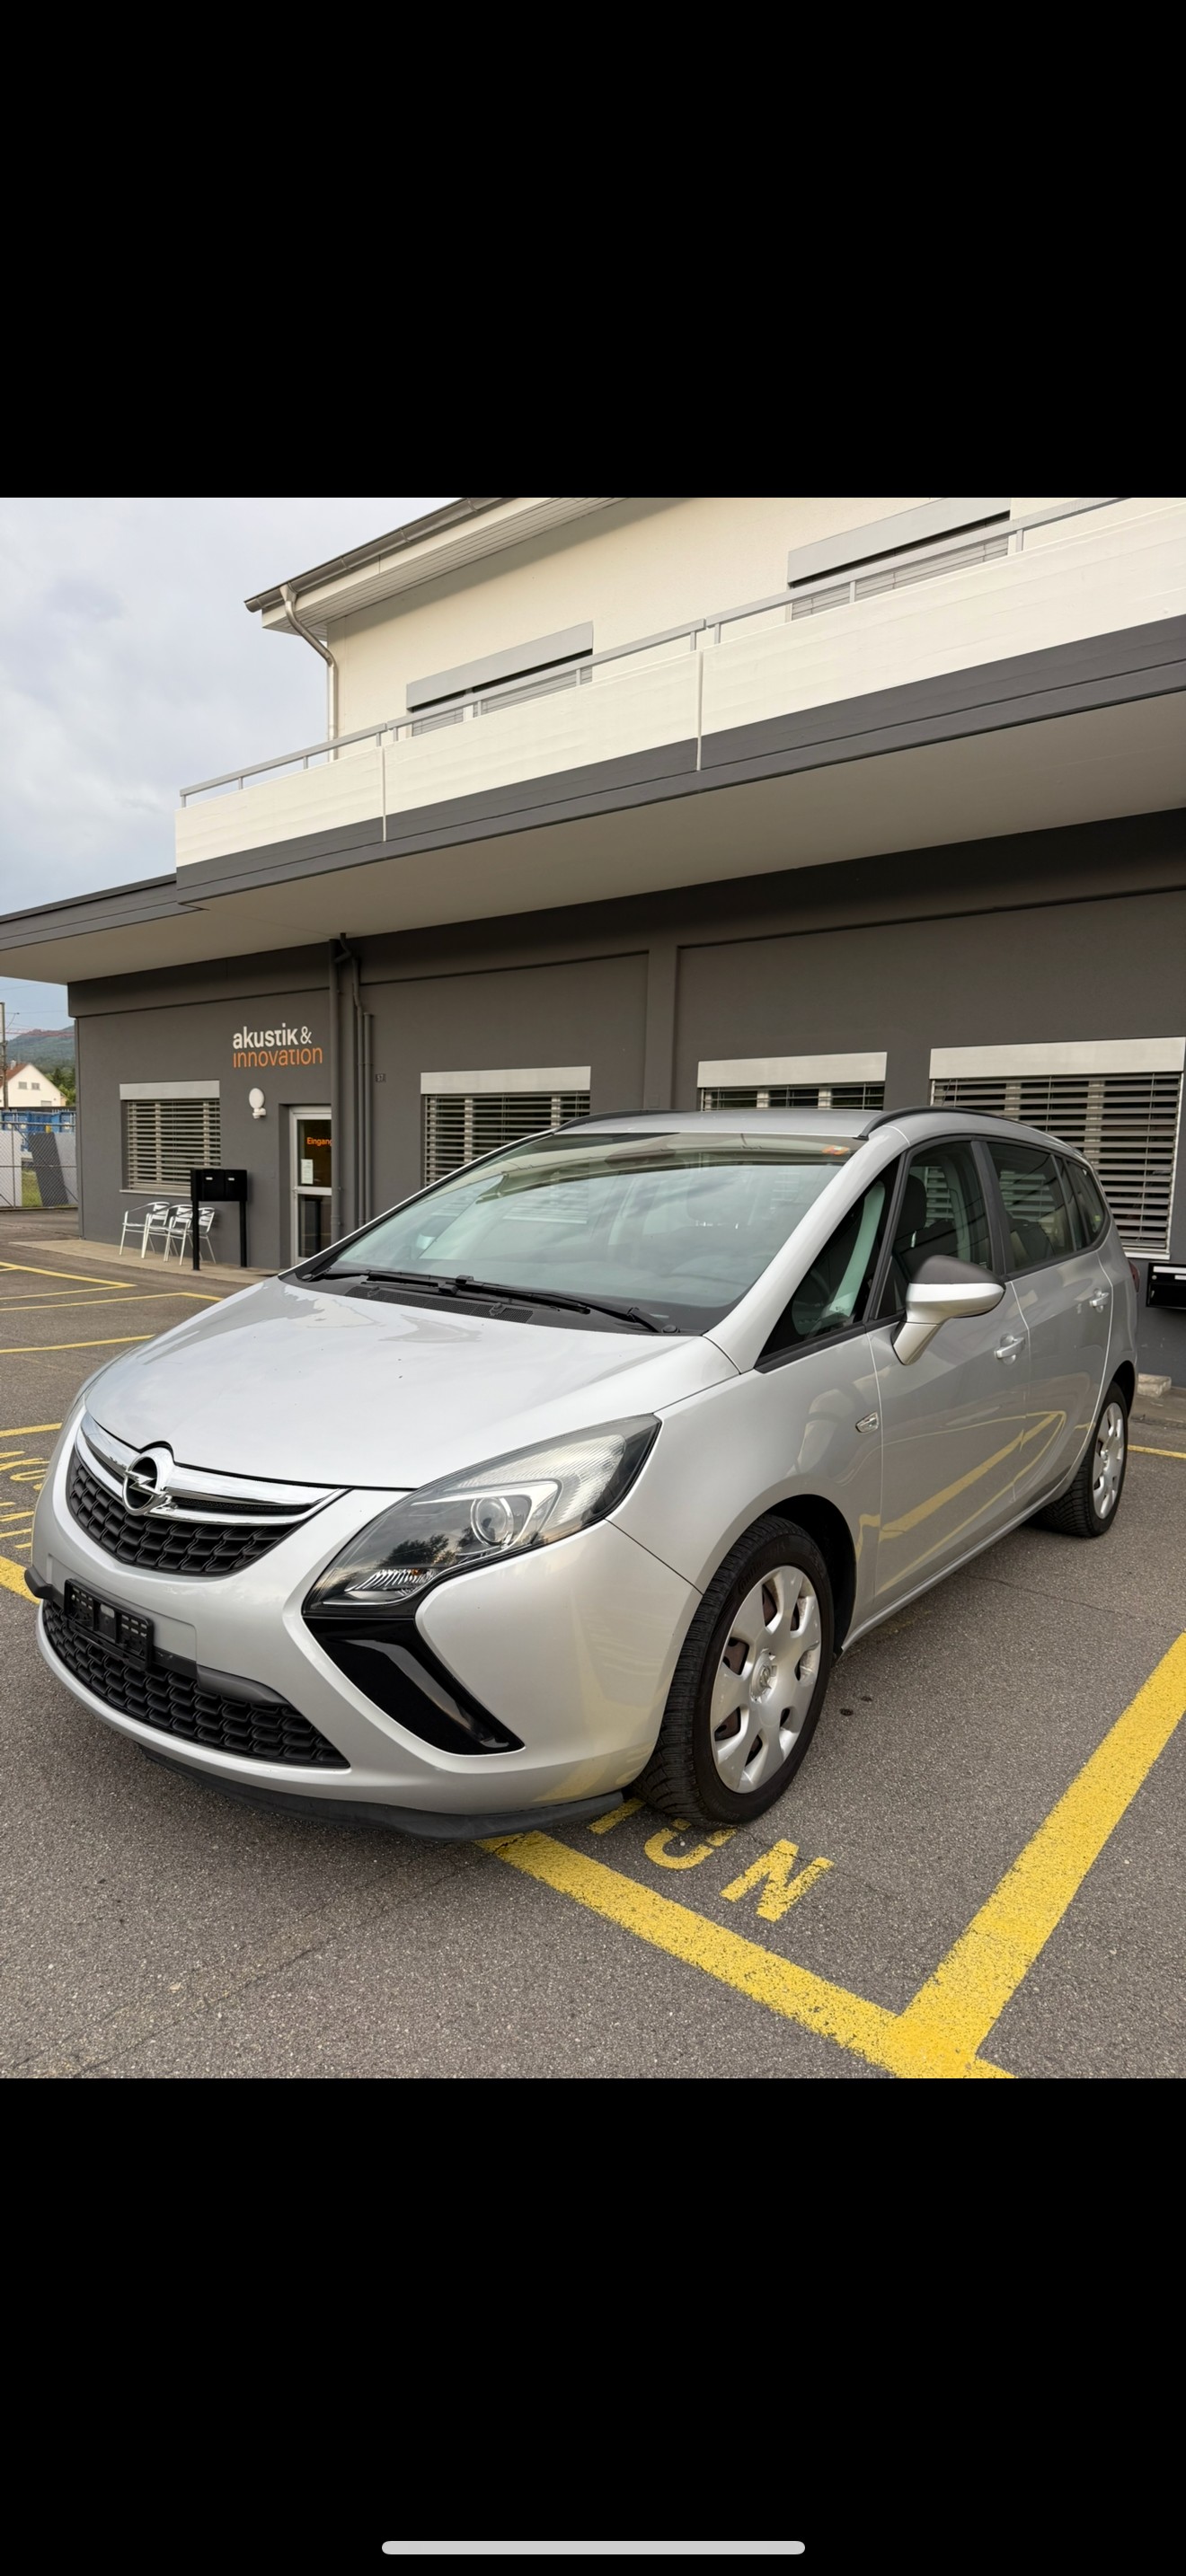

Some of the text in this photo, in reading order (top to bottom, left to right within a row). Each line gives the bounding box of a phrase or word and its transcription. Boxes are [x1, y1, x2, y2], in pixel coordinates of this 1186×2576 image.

[233, 1022, 313, 1050] akustik &
[233, 1047, 323, 1069] innovation
